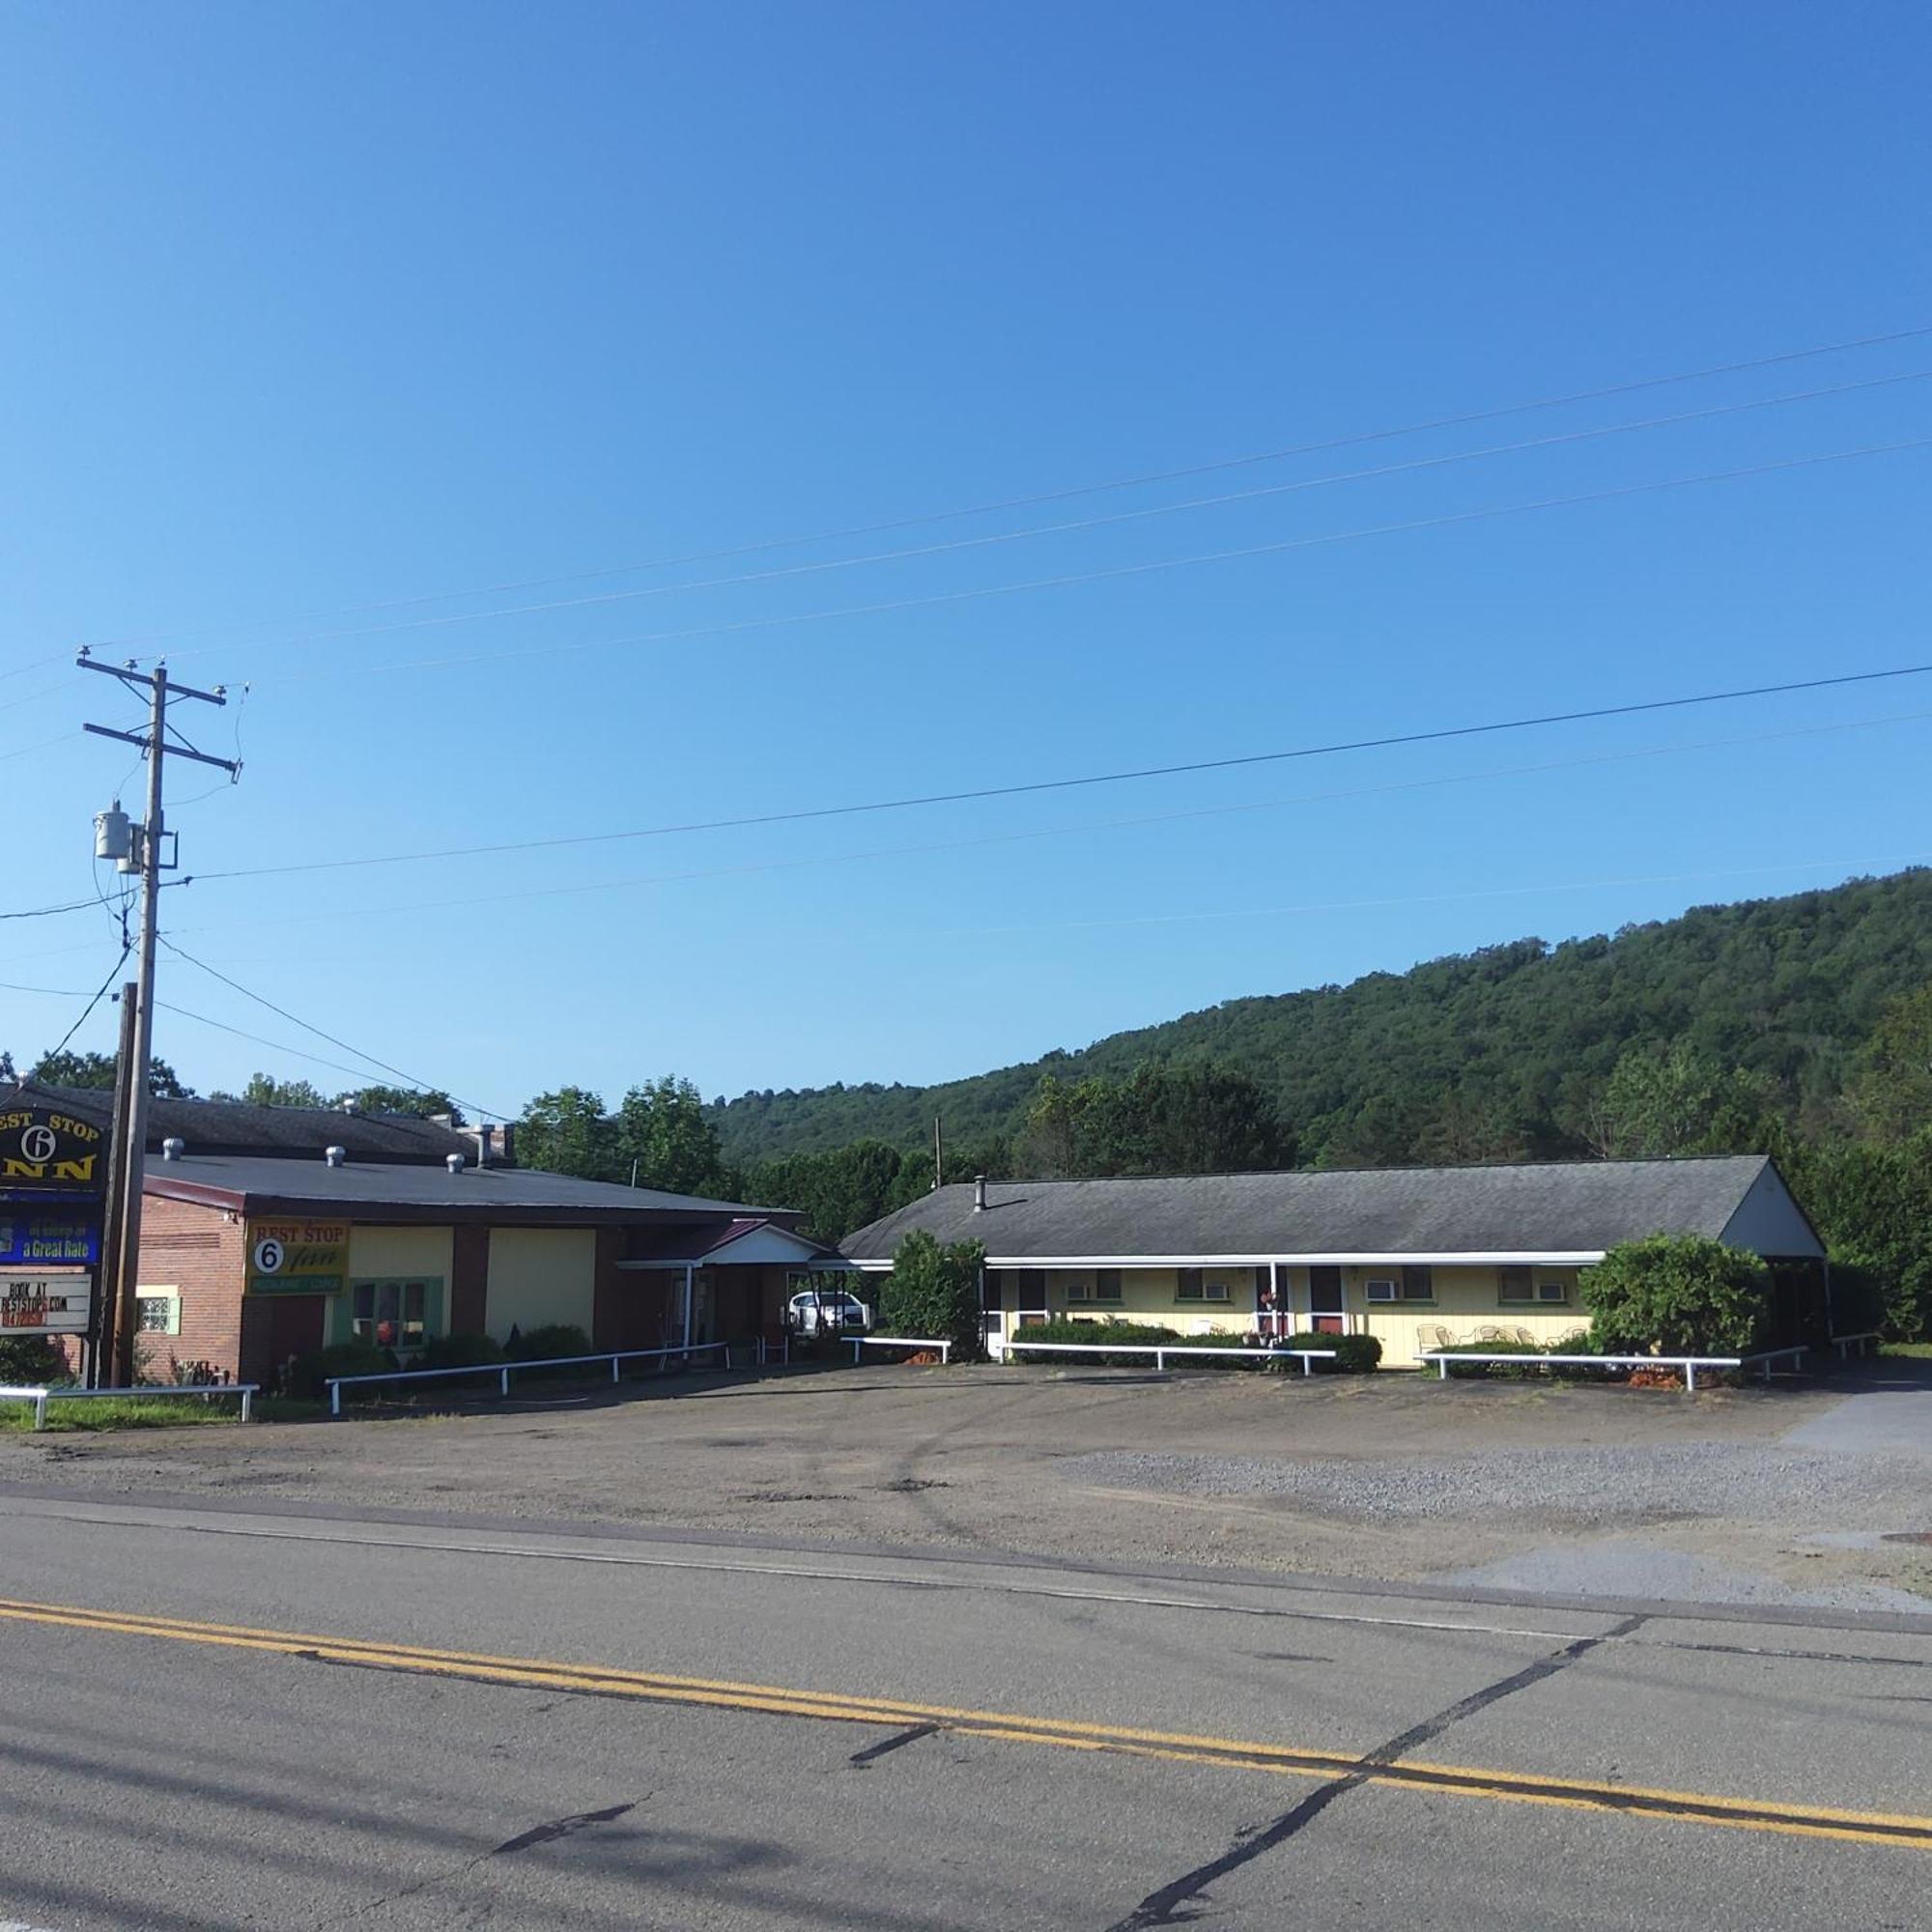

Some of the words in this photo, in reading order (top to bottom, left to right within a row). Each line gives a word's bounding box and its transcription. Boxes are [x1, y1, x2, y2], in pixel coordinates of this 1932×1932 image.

[49, 1114, 99, 1143] STOP
[24, 1128, 52, 1160] 6
[256, 1226, 298, 1243] REST
[304, 1226, 343, 1243] STOP
[32, 1239, 62, 1258] Great
[261, 1242, 278, 1268] 6
[10, 1283, 30, 1297] BOOK
[36, 1283, 47, 1297] AT
